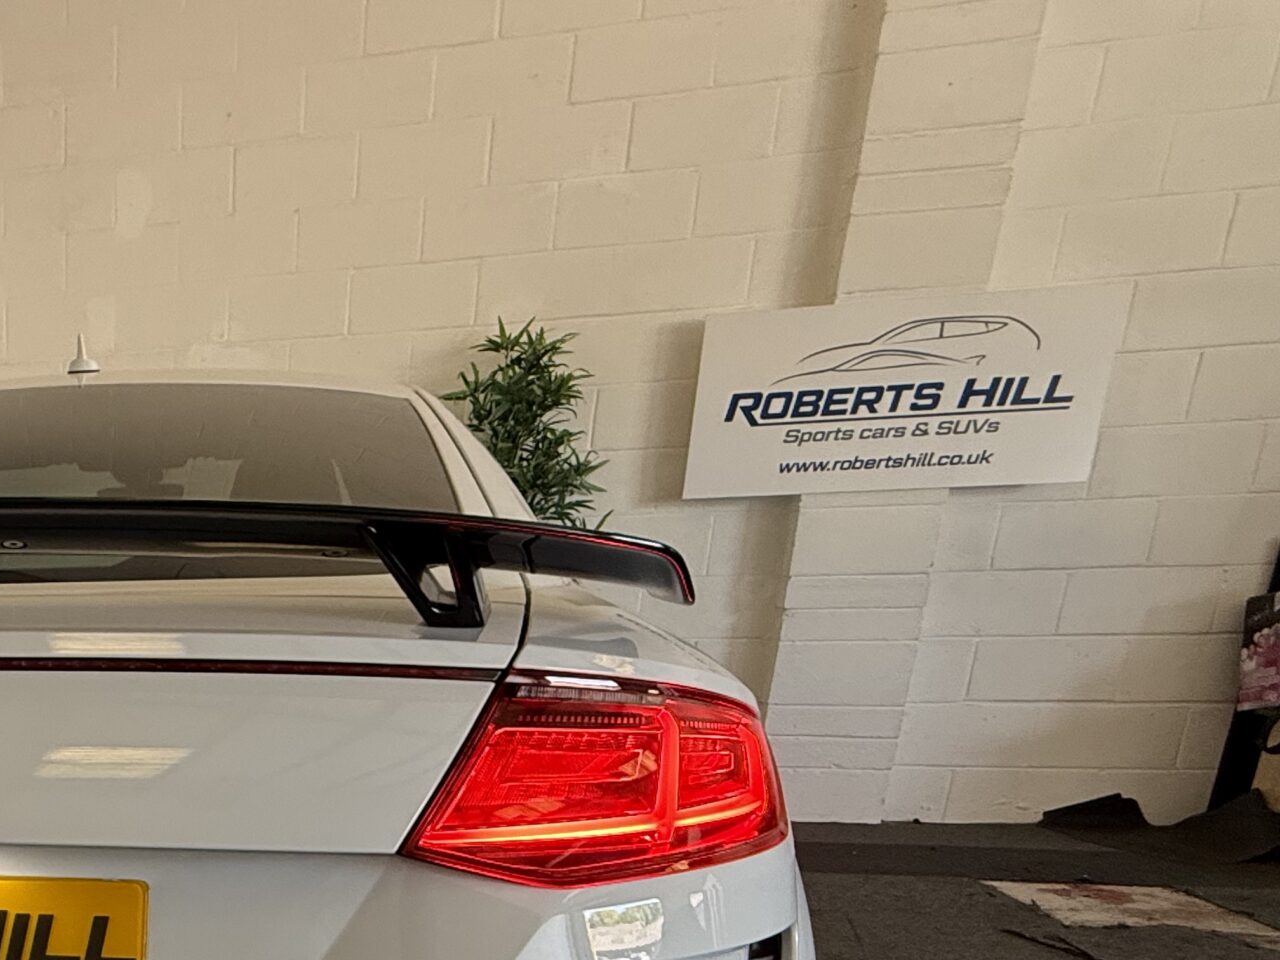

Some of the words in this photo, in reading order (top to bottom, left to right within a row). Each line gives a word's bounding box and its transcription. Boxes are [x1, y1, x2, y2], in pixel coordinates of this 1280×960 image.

[724, 382, 944, 426] ROBERTS
[958, 374, 1074, 409] HILL
[783, 426, 855, 447] Sports
[859, 425, 906, 440] cars
[911, 422, 930, 437] &
[935, 418, 1001, 437] SUVs
[778, 449, 994, 475] www.robertshill.co.uk
